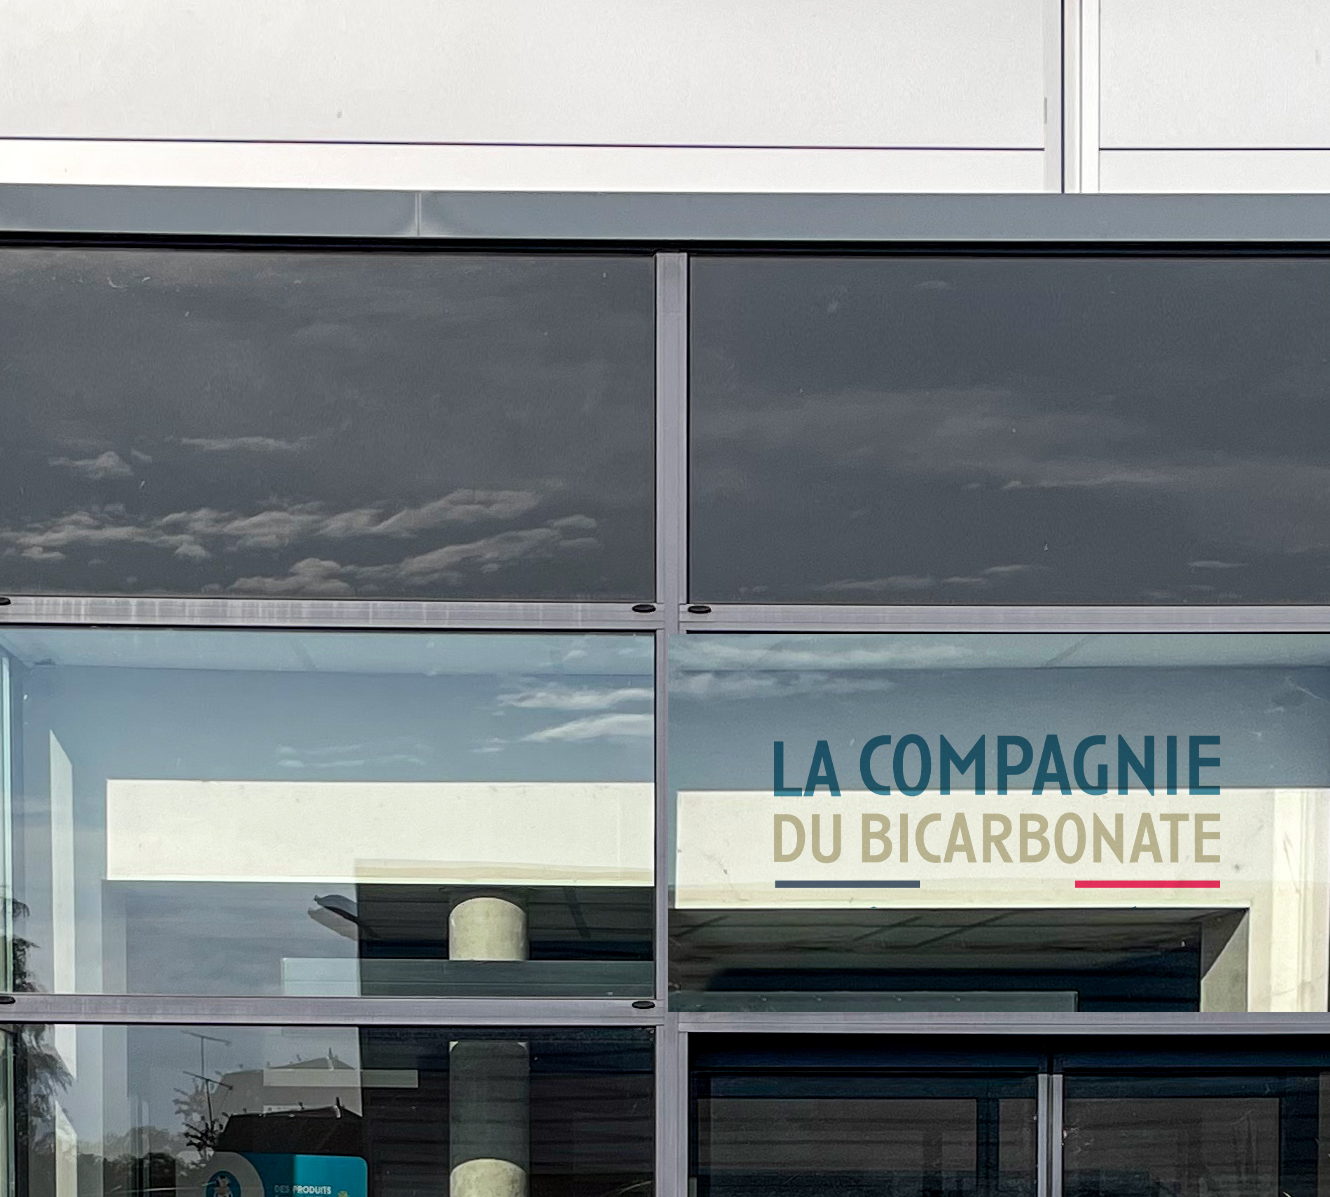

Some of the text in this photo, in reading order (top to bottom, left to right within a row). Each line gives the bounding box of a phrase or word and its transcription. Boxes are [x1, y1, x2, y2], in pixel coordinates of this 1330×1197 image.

[773, 734, 1221, 797] LA COMPAGNIE
[773, 812, 1221, 864] DU BICARBONATE
[274, 1185, 332, 1194] DES PRODUITS
